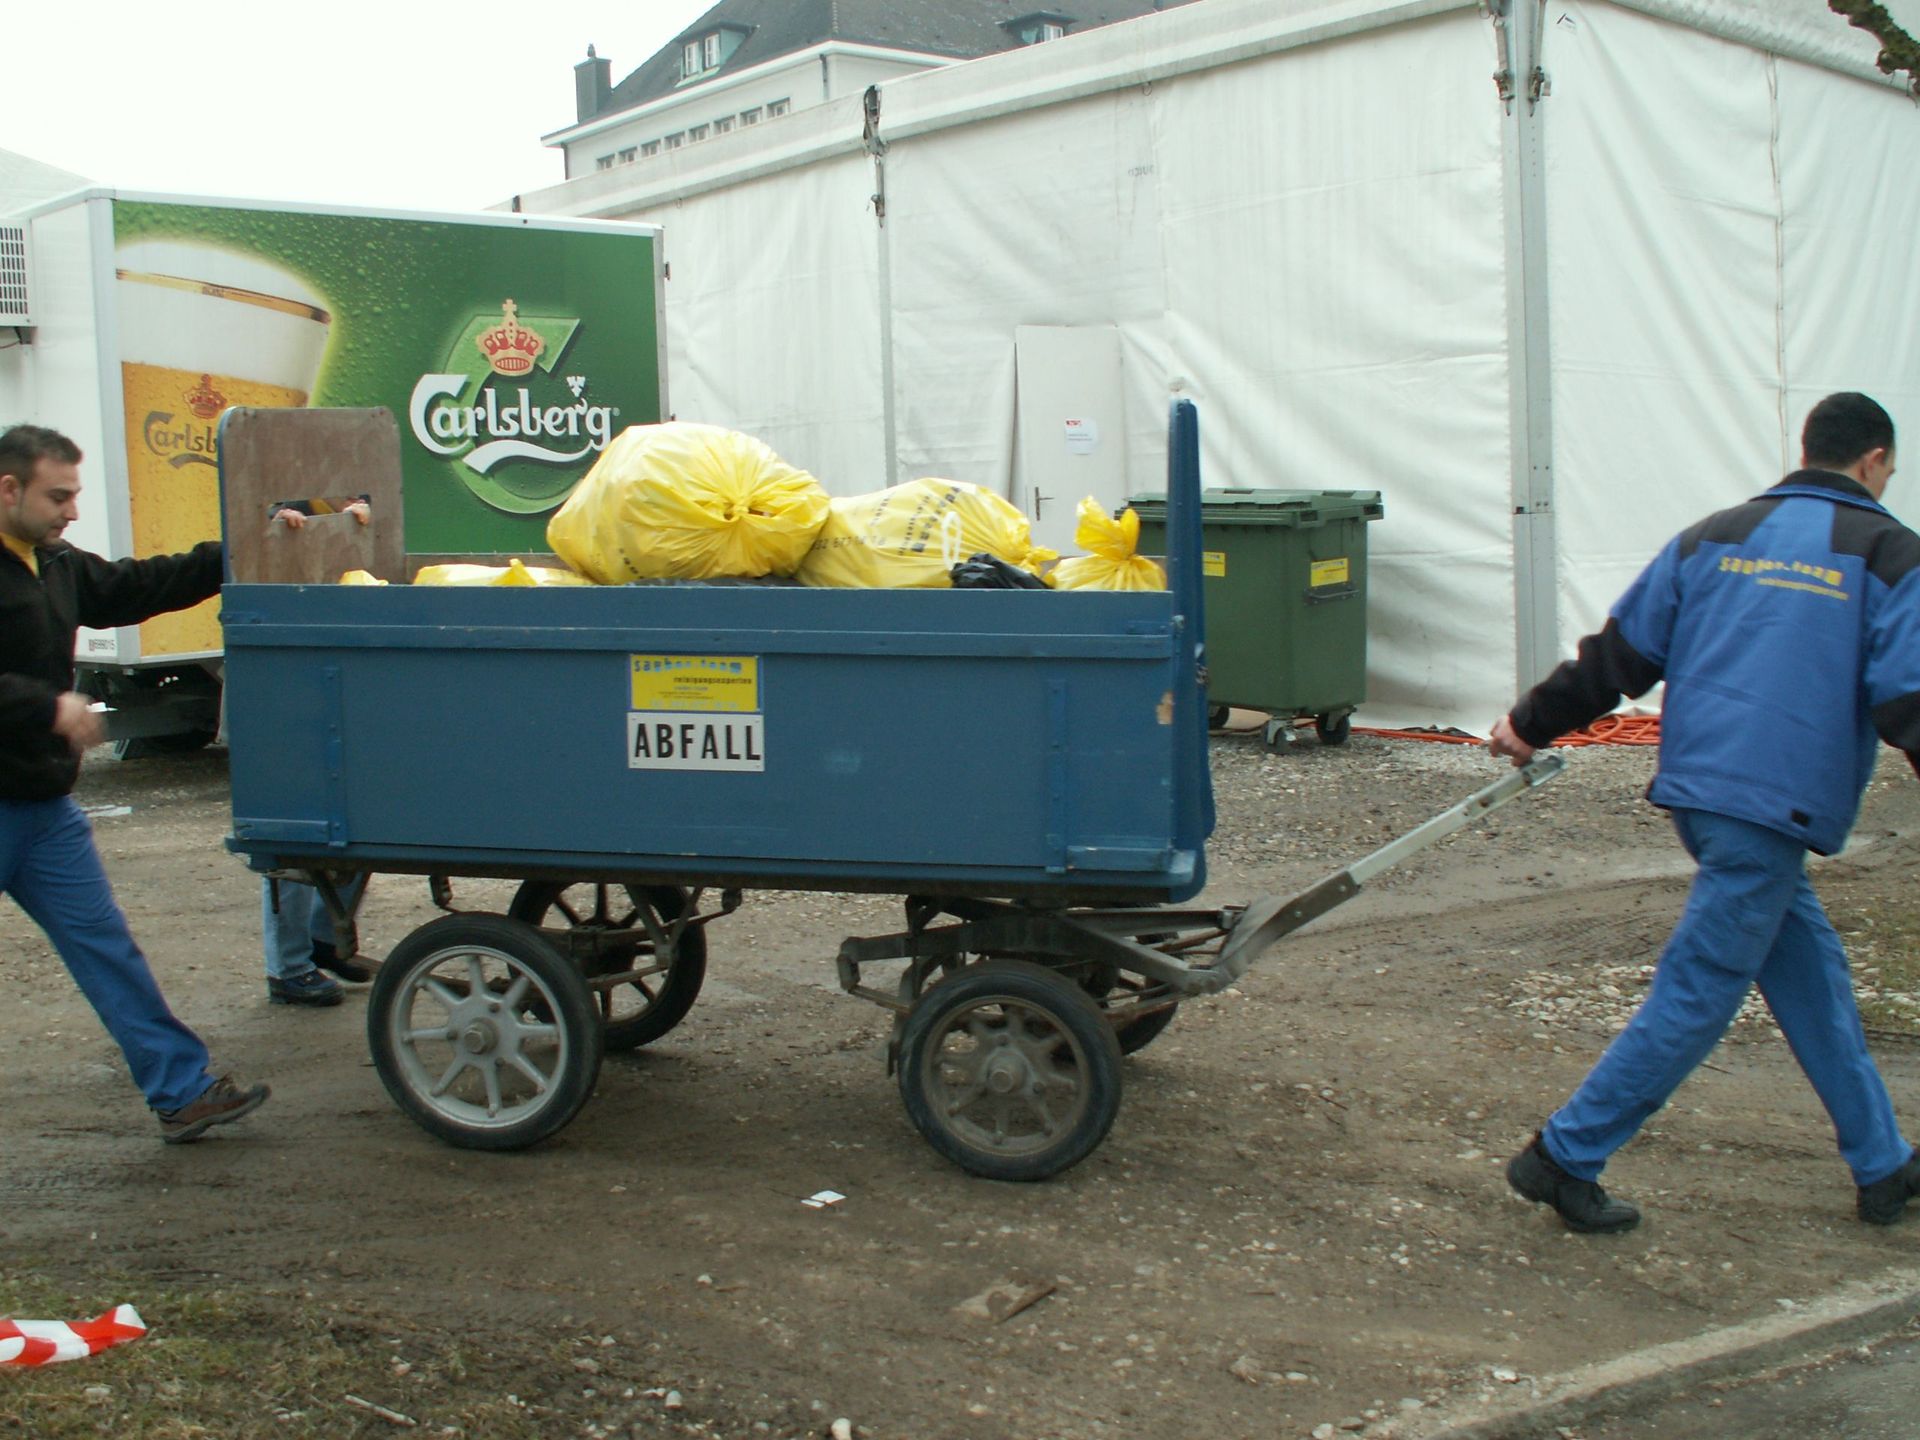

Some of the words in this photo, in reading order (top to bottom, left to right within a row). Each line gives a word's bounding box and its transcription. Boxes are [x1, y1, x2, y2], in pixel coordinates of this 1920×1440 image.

[144, 411, 219, 469] Carlsb
[410, 374, 612, 473] Carlsberg
[634, 723, 761, 761] ABFALL
